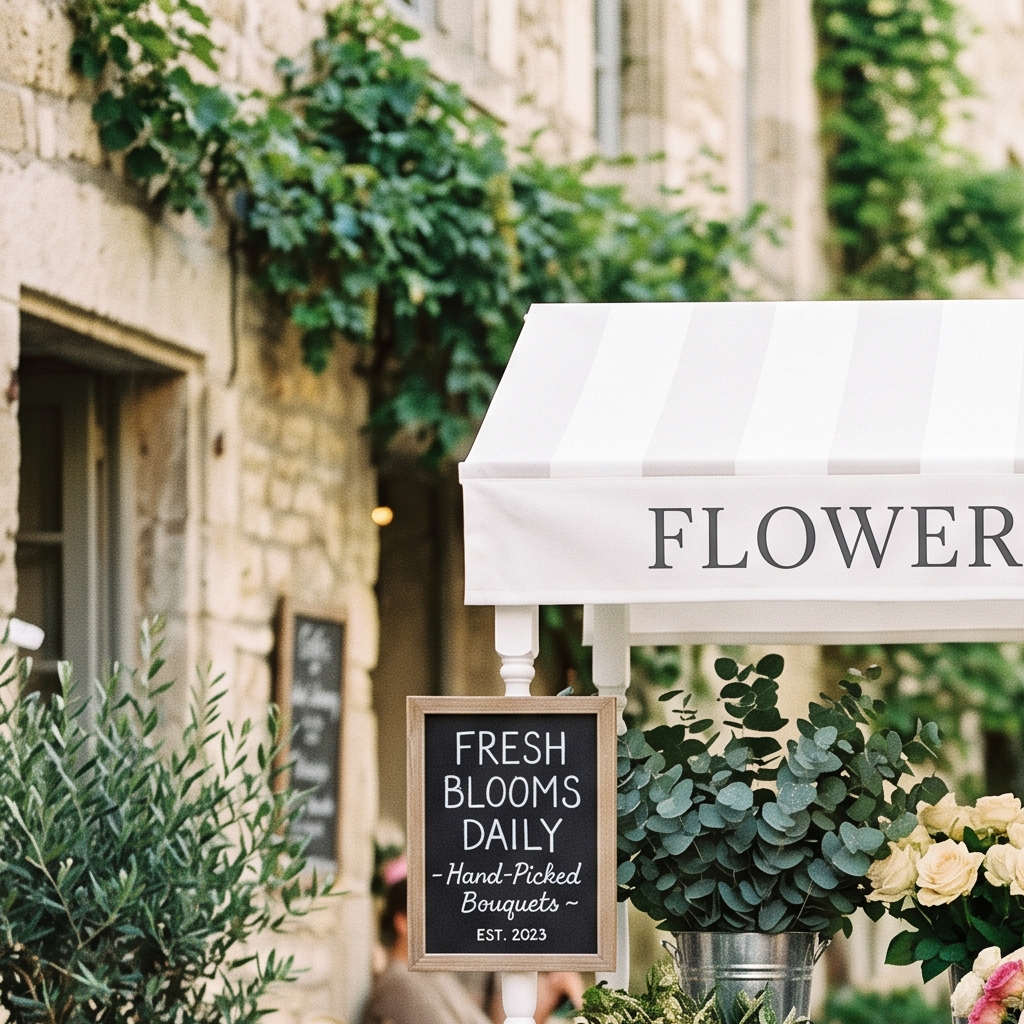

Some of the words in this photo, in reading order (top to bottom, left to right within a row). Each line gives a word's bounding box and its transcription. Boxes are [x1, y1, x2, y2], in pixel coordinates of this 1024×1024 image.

[649, 506, 1023, 570] FLOWER
[456, 730, 566, 765] FRESH
[444, 774, 581, 809] BLOOMS
[463, 818, 563, 853] DAILY
[476, 928, 507, 942] EST.
[511, 928, 547, 942] 2023
